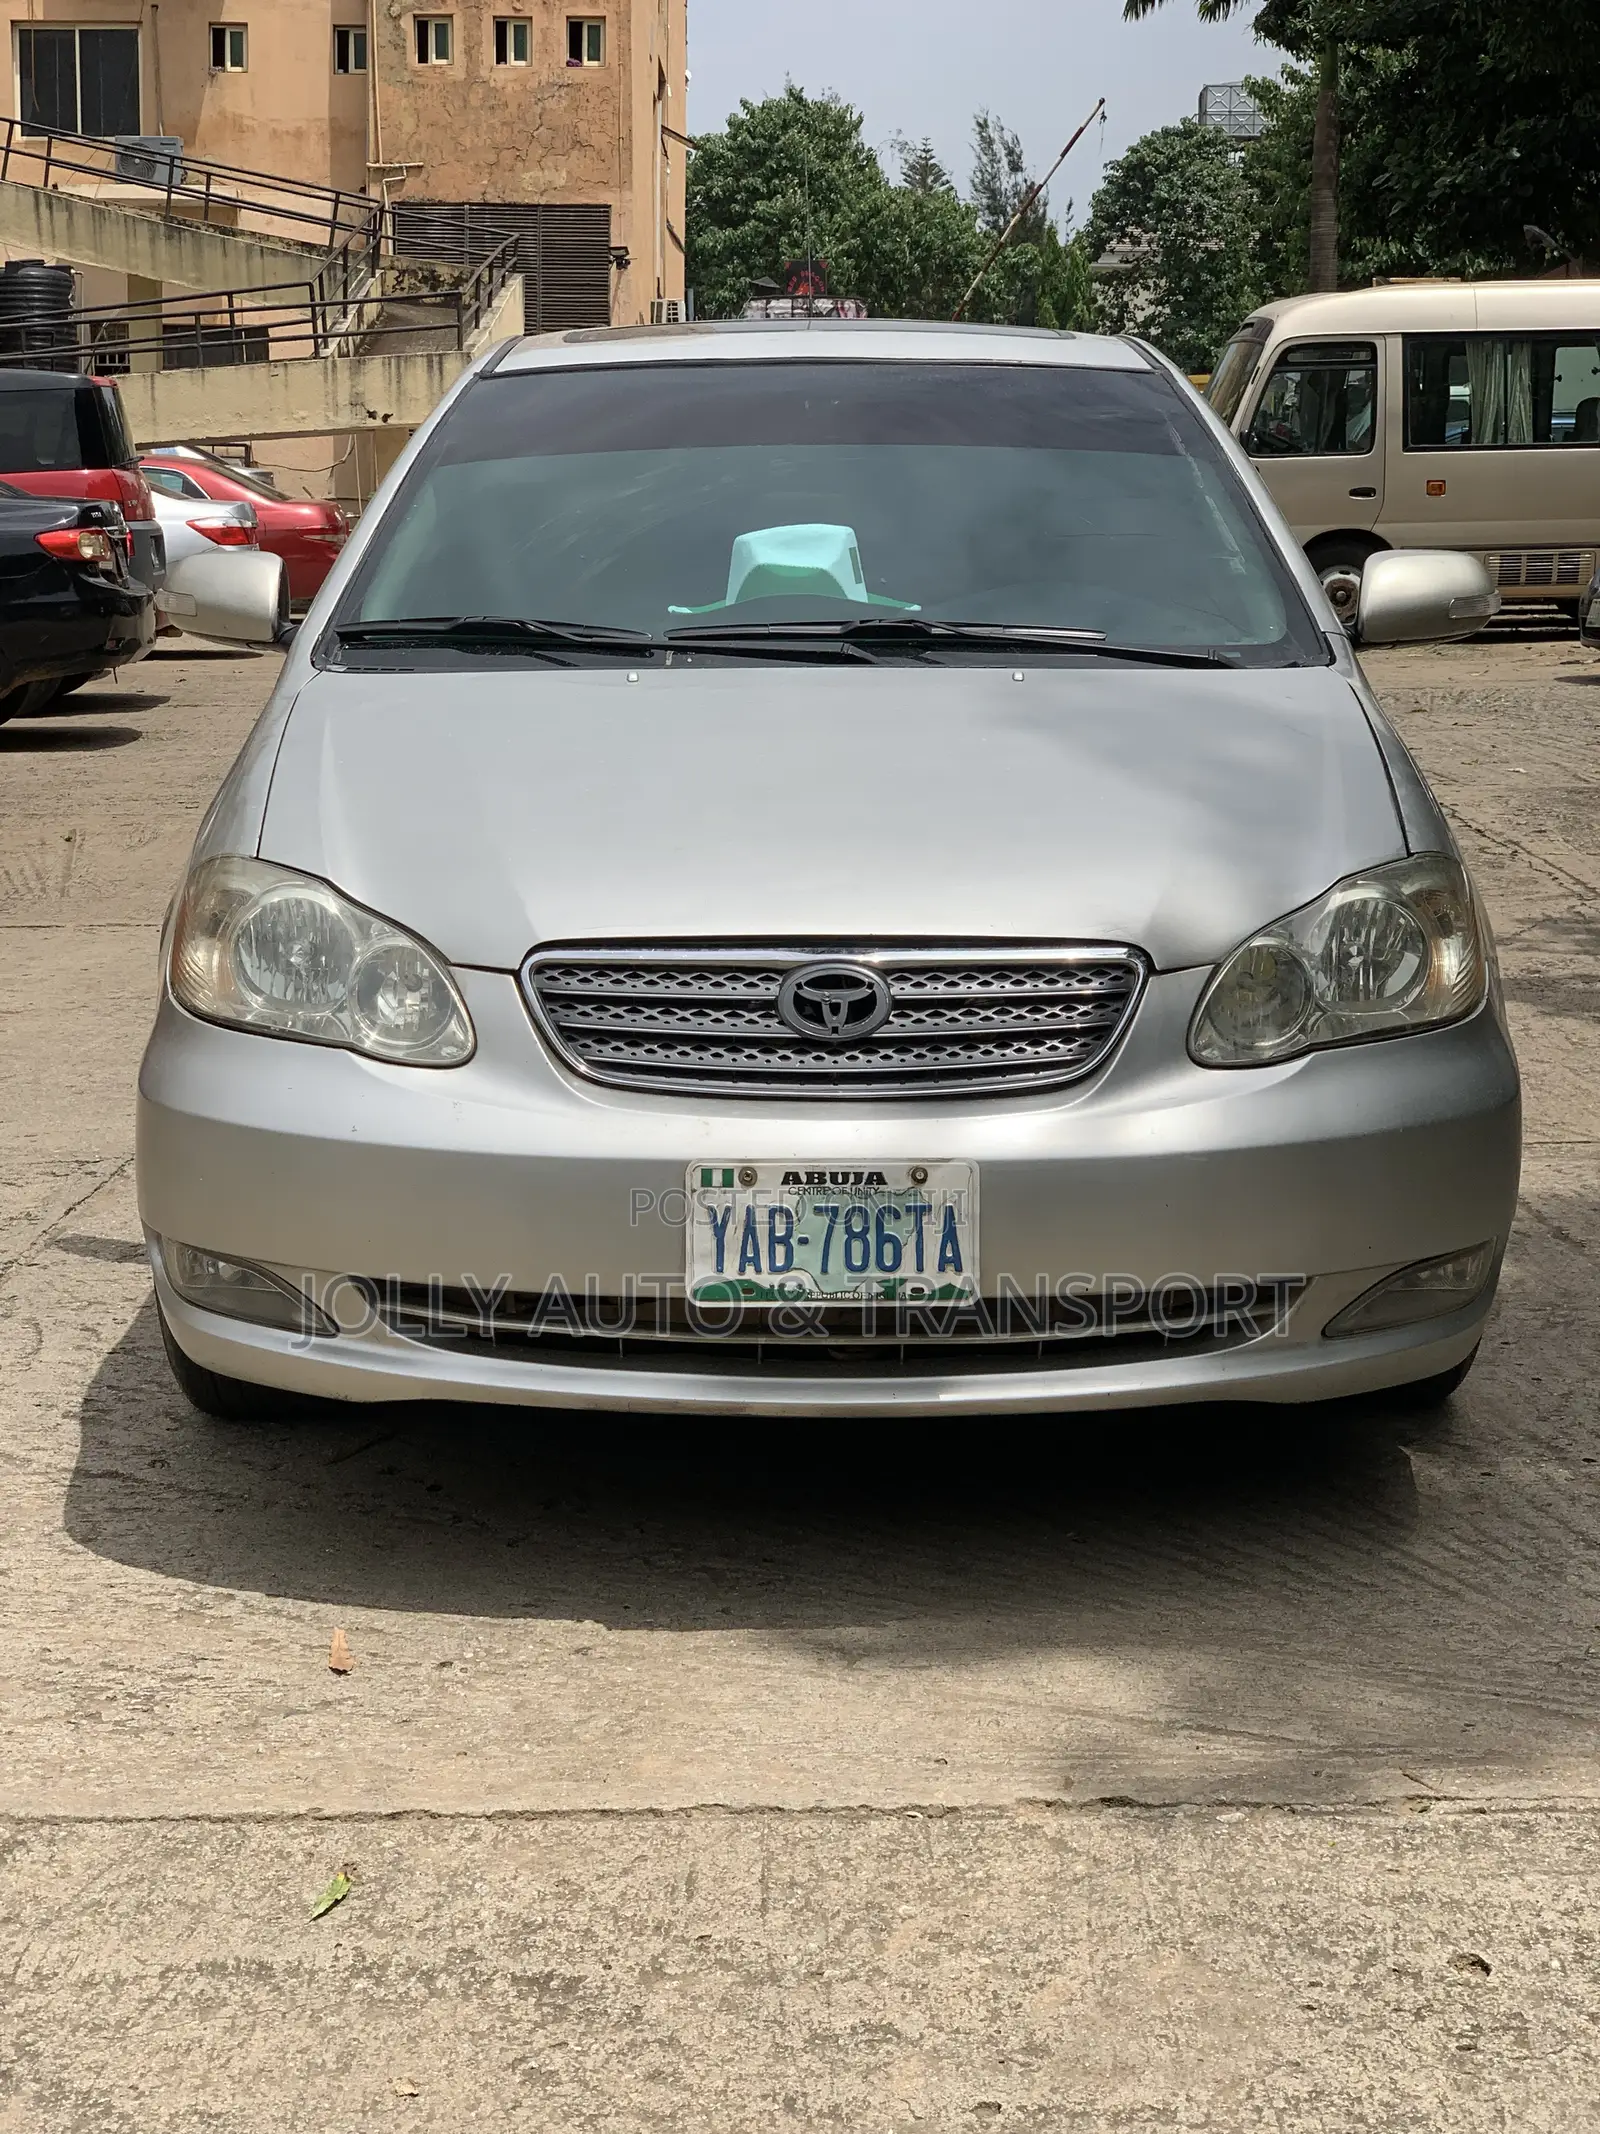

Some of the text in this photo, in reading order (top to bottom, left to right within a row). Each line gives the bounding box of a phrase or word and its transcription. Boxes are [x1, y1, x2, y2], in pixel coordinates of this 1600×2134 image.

[780, 1171, 889, 1186] ABUJA
[788, 1186, 829, 1196] CENTRE
[707, 1203, 964, 1274] YAB-786TA
